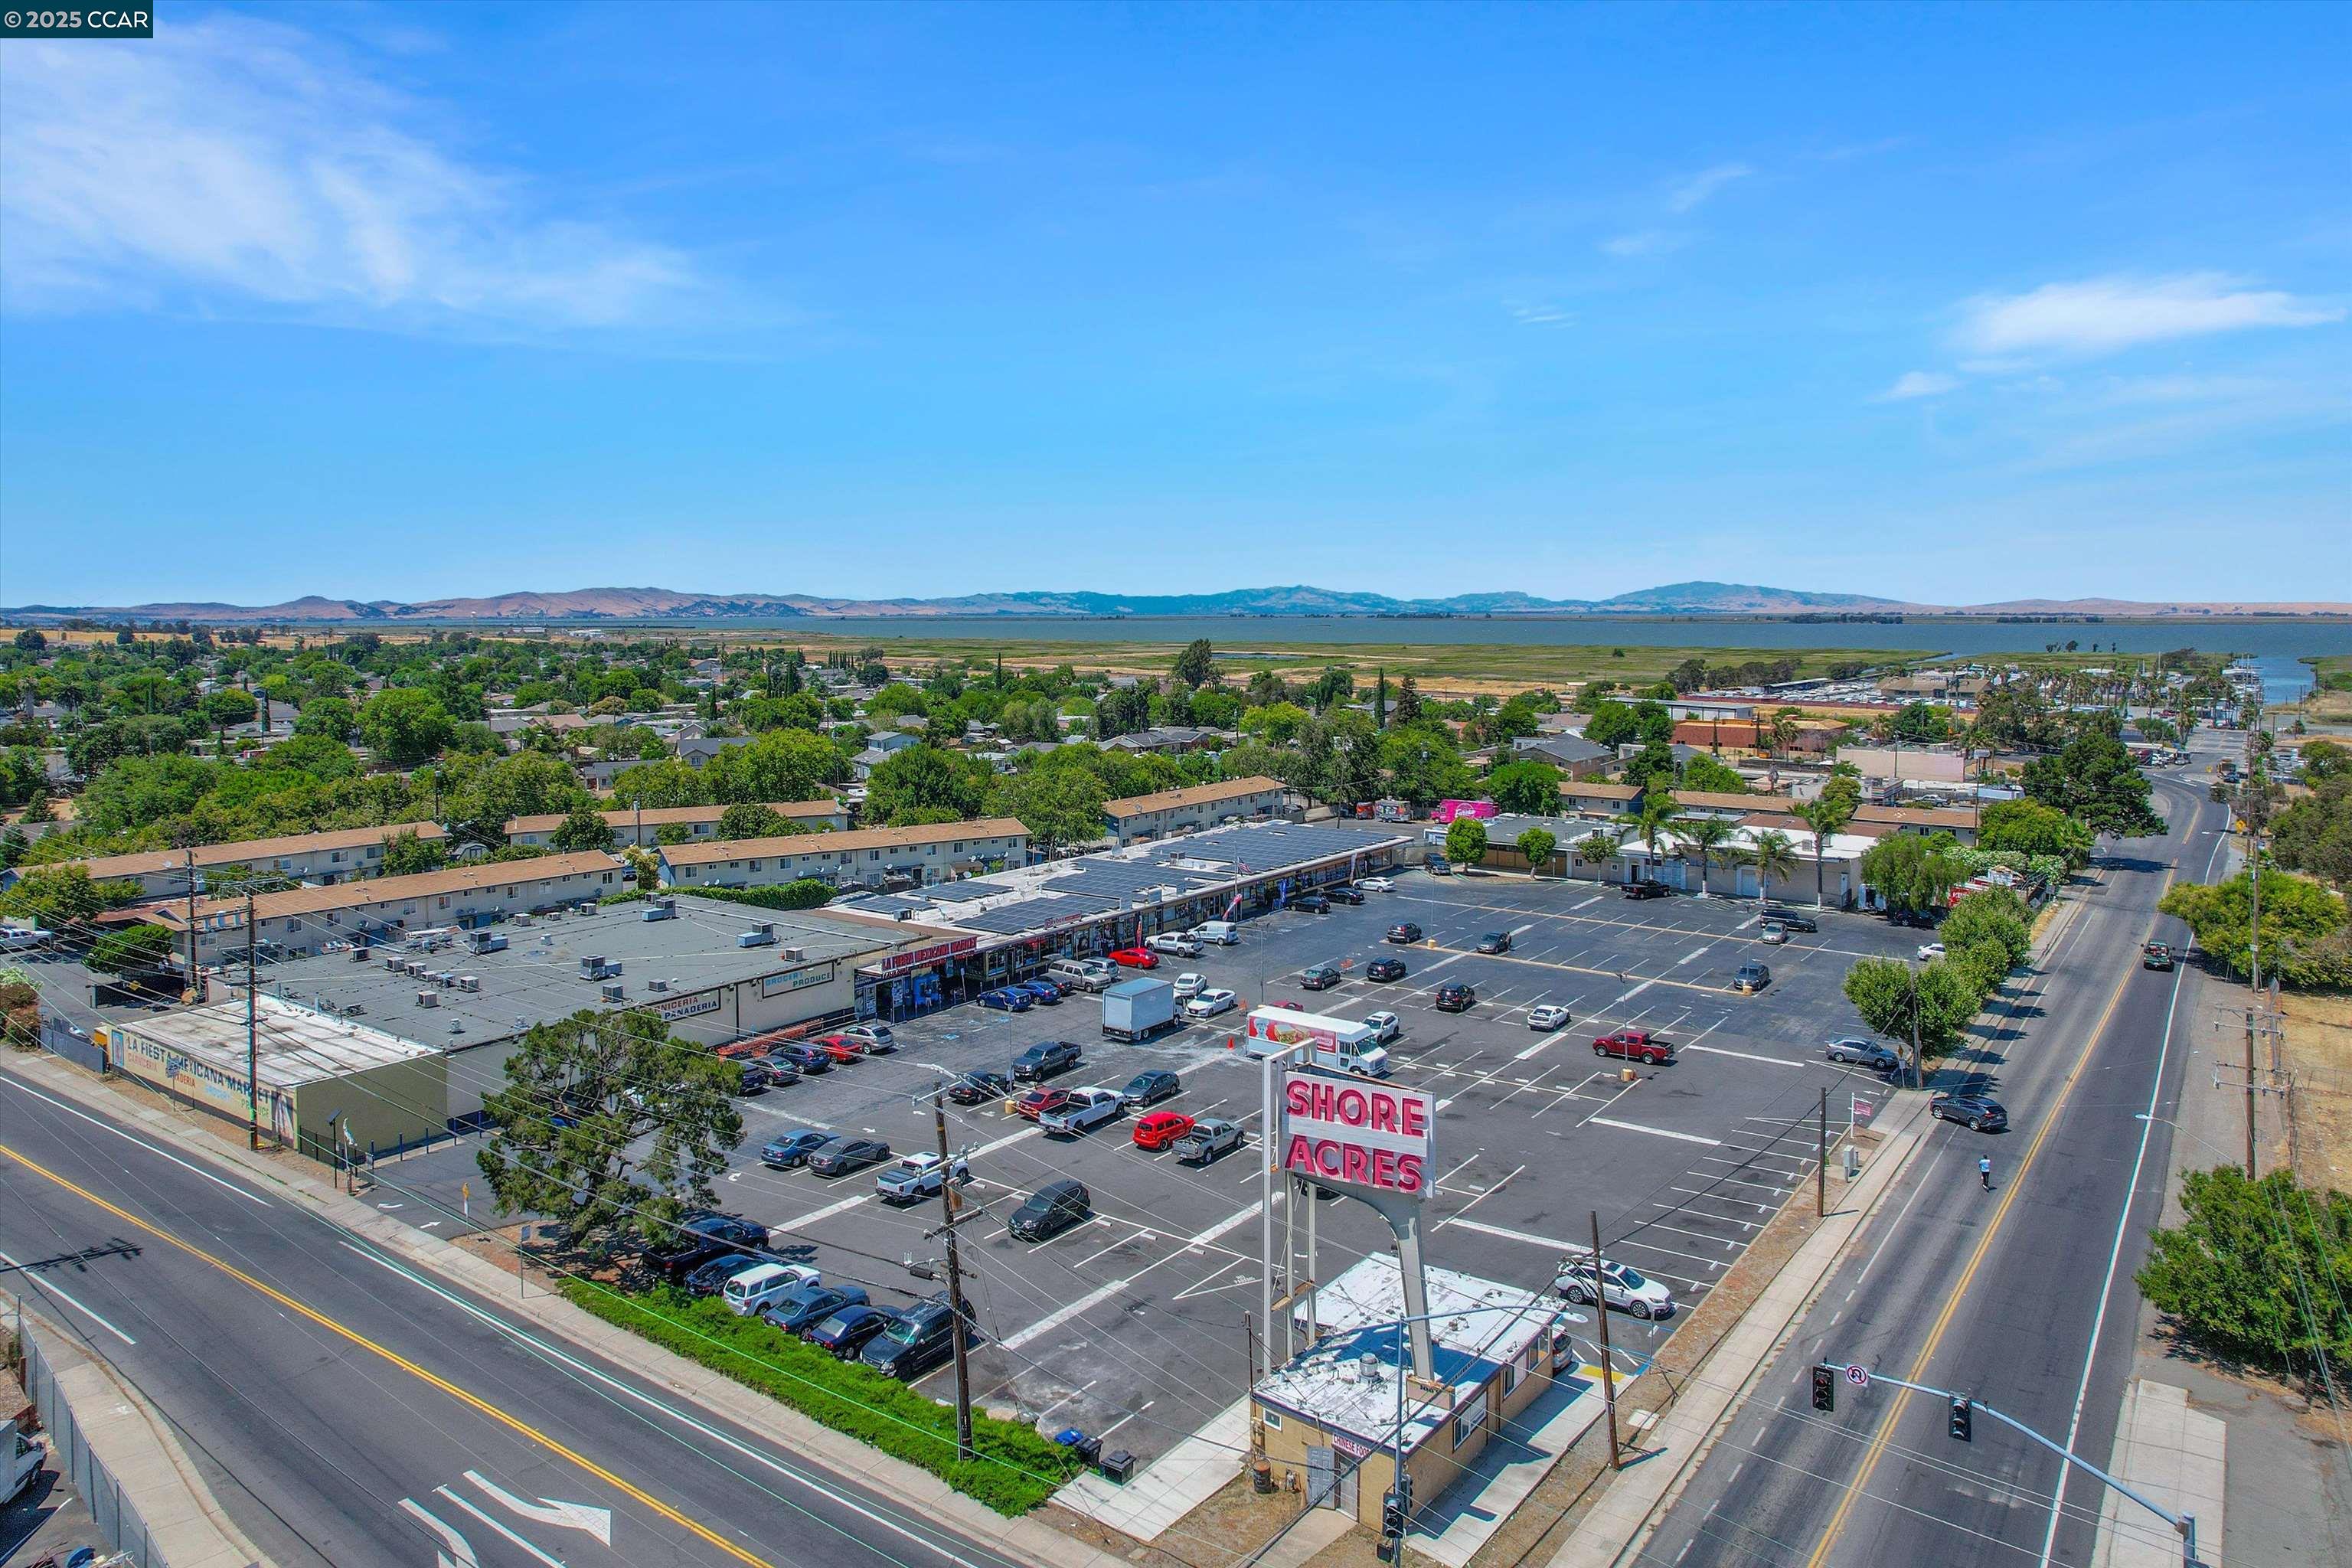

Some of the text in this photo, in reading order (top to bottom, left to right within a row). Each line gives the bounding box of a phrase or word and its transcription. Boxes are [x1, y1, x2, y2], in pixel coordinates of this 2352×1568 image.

[766, 972, 804, 987] GROCERY
[792, 972, 832, 988] PRODUCE
[665, 1001, 717, 1020] PANADERIA
[127, 1036, 139, 1052] LA
[226, 1075, 270, 1104] MARET
[1286, 1080, 1424, 1138] SHORE
[1285, 1134, 1423, 1193] ACRES
[1333, 1433, 1355, 1452] CHINESE
